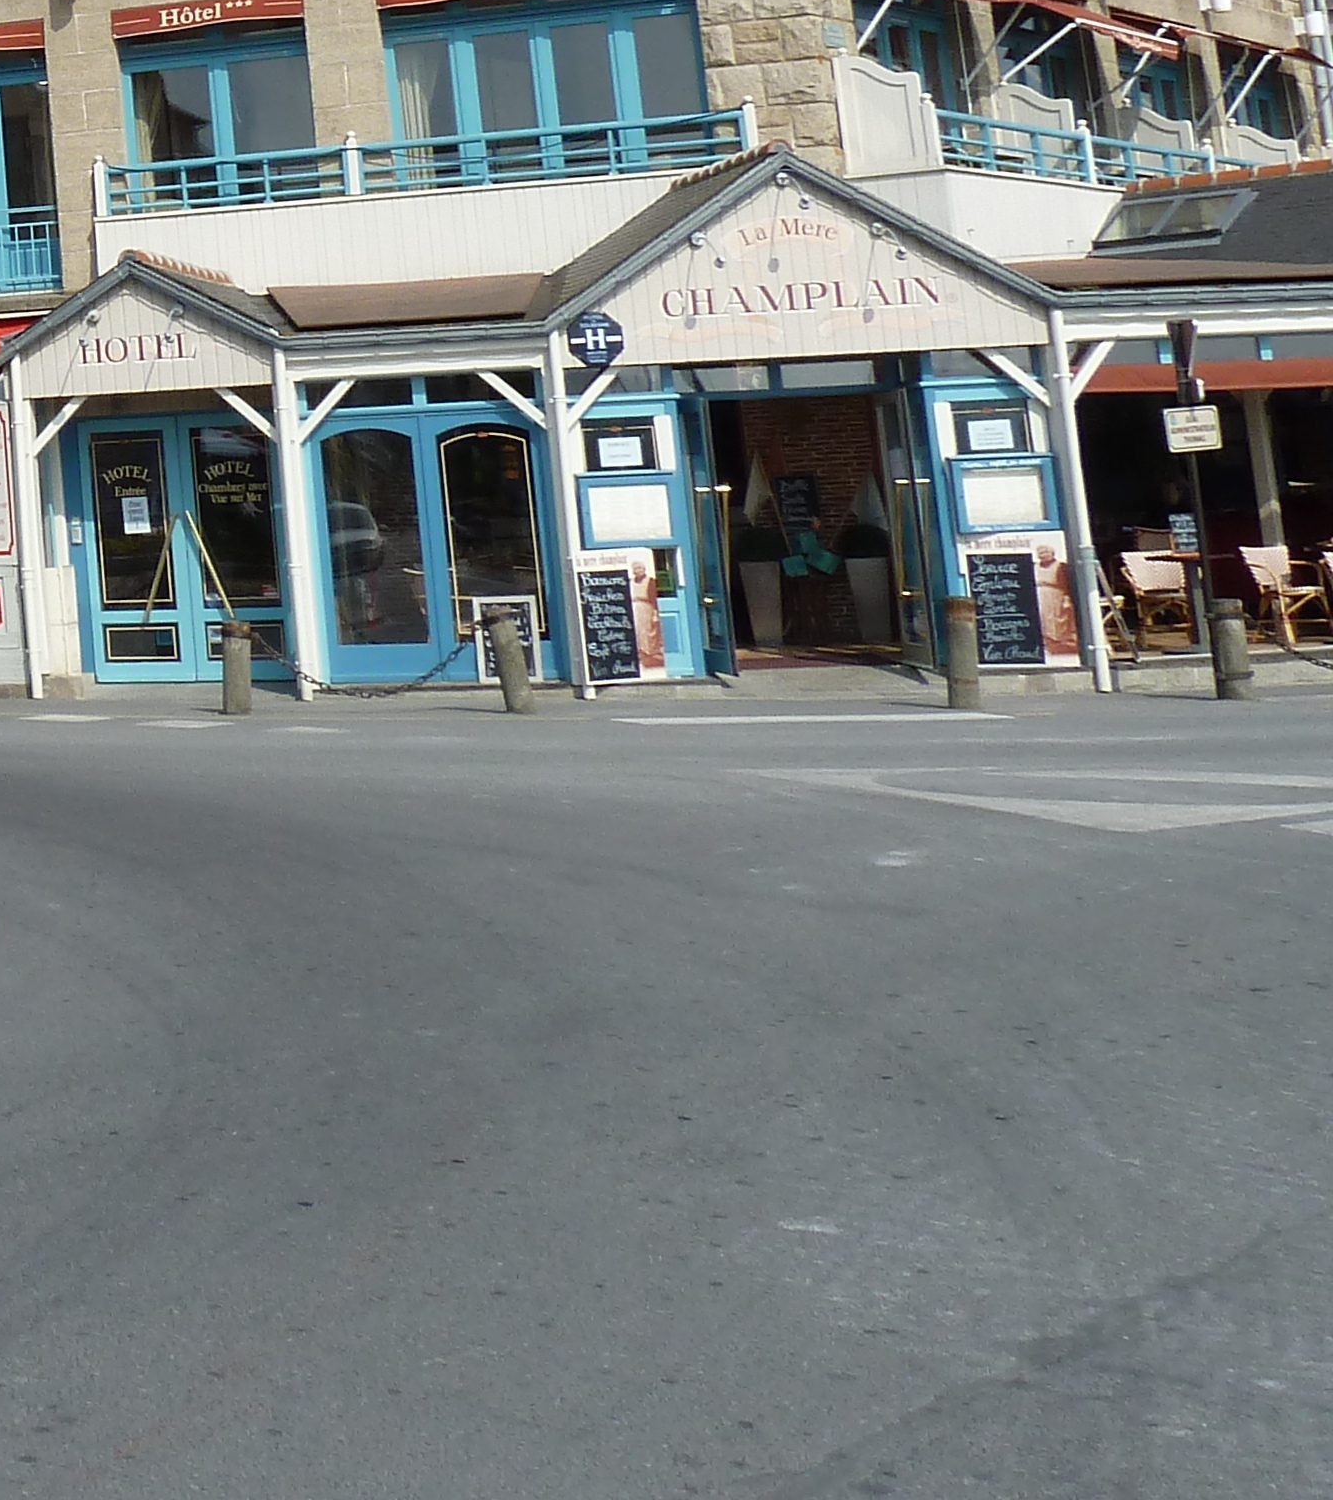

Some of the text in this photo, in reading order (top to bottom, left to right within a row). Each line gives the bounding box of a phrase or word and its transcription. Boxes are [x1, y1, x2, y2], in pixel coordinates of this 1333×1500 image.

[661, 276, 940, 318] CHAMPLAIN
[78, 333, 197, 367] HOTEL
[585, 328, 606, 350] H
[102, 460, 255, 486] HOTEL HOTEL
